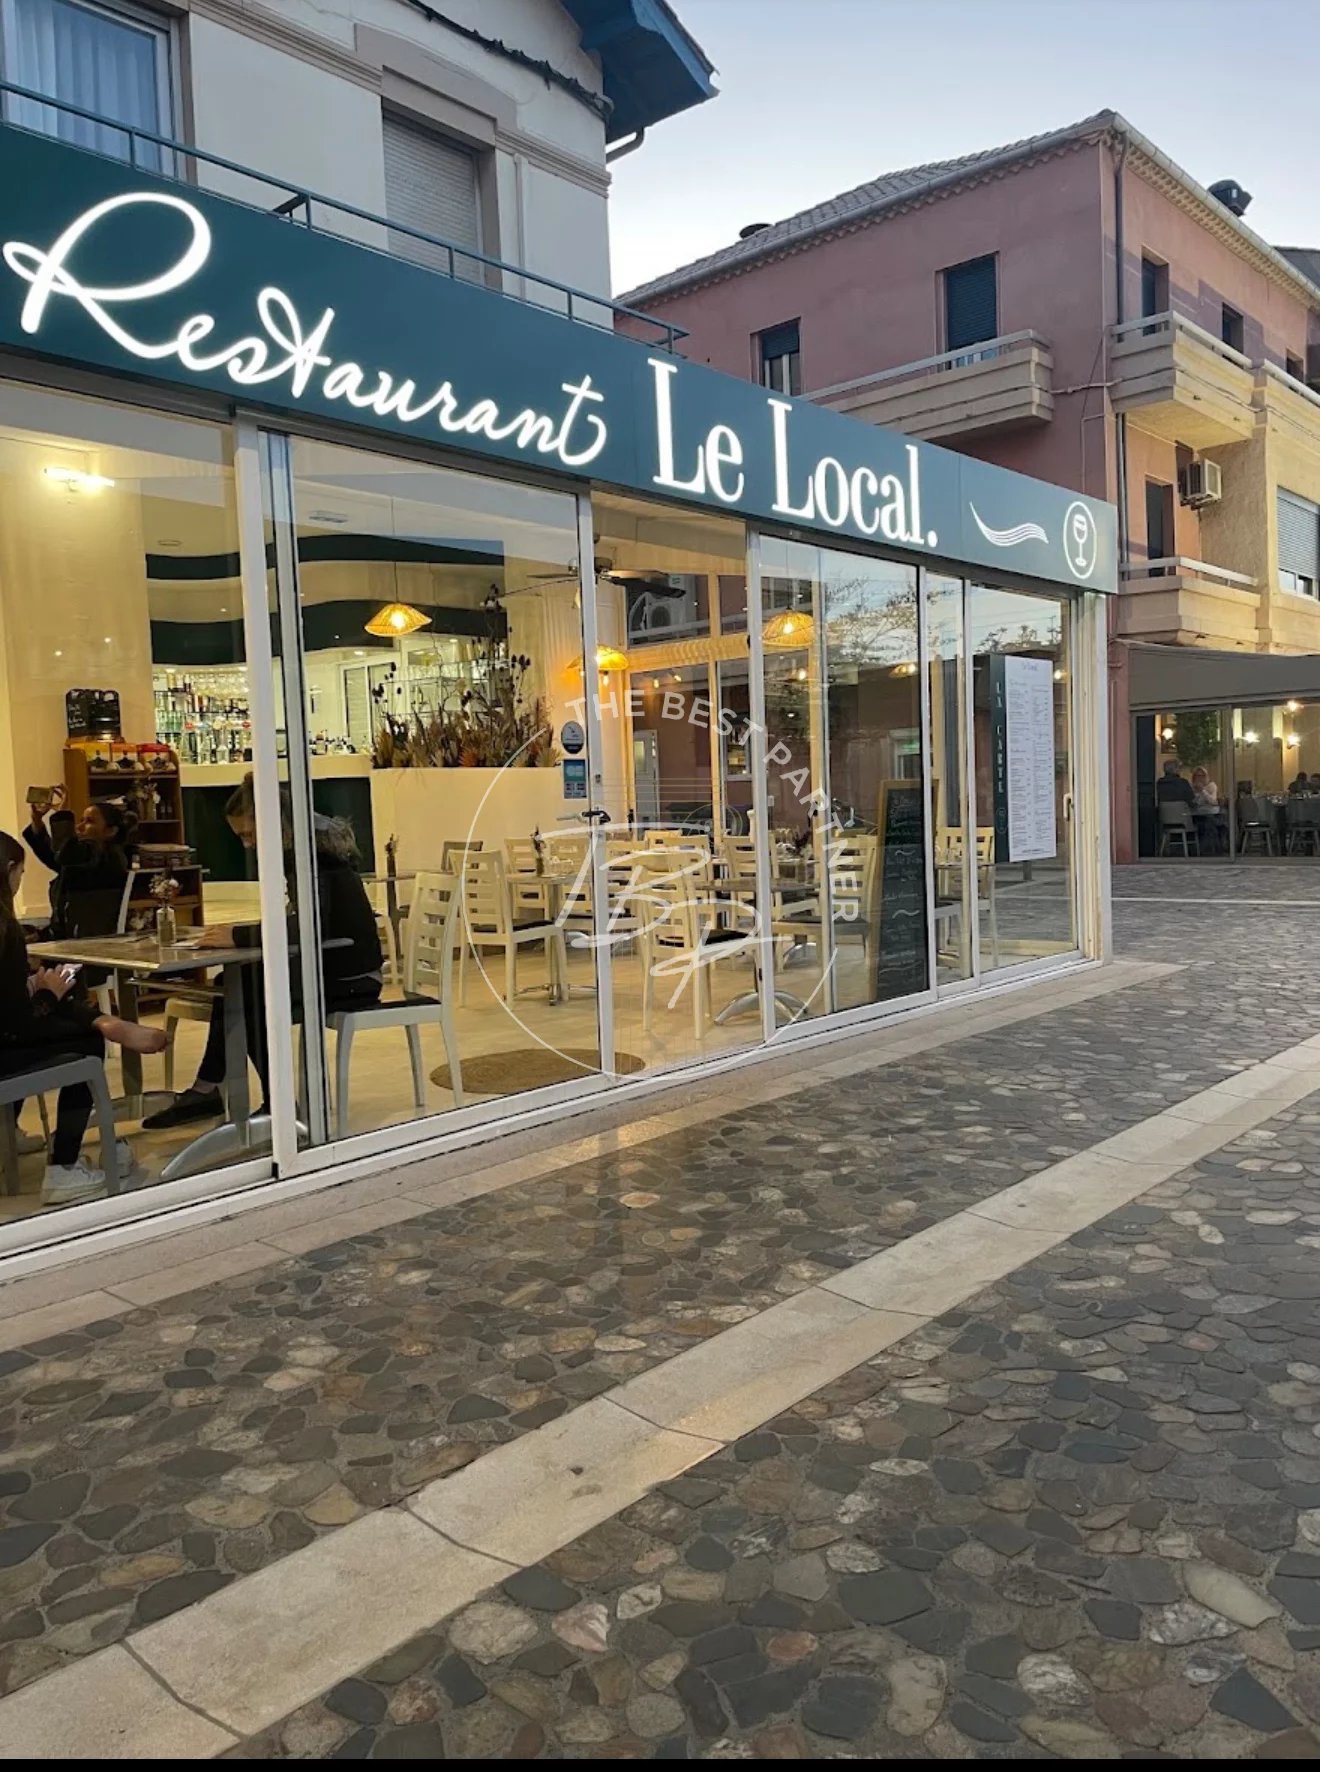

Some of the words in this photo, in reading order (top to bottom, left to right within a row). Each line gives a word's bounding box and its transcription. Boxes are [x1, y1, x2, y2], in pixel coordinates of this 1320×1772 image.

[2, 192, 608, 466] Restaurant
[647, 357, 745, 503] Le
[767, 398, 939, 548] Local.
[996, 725, 1004, 793] CARTE
